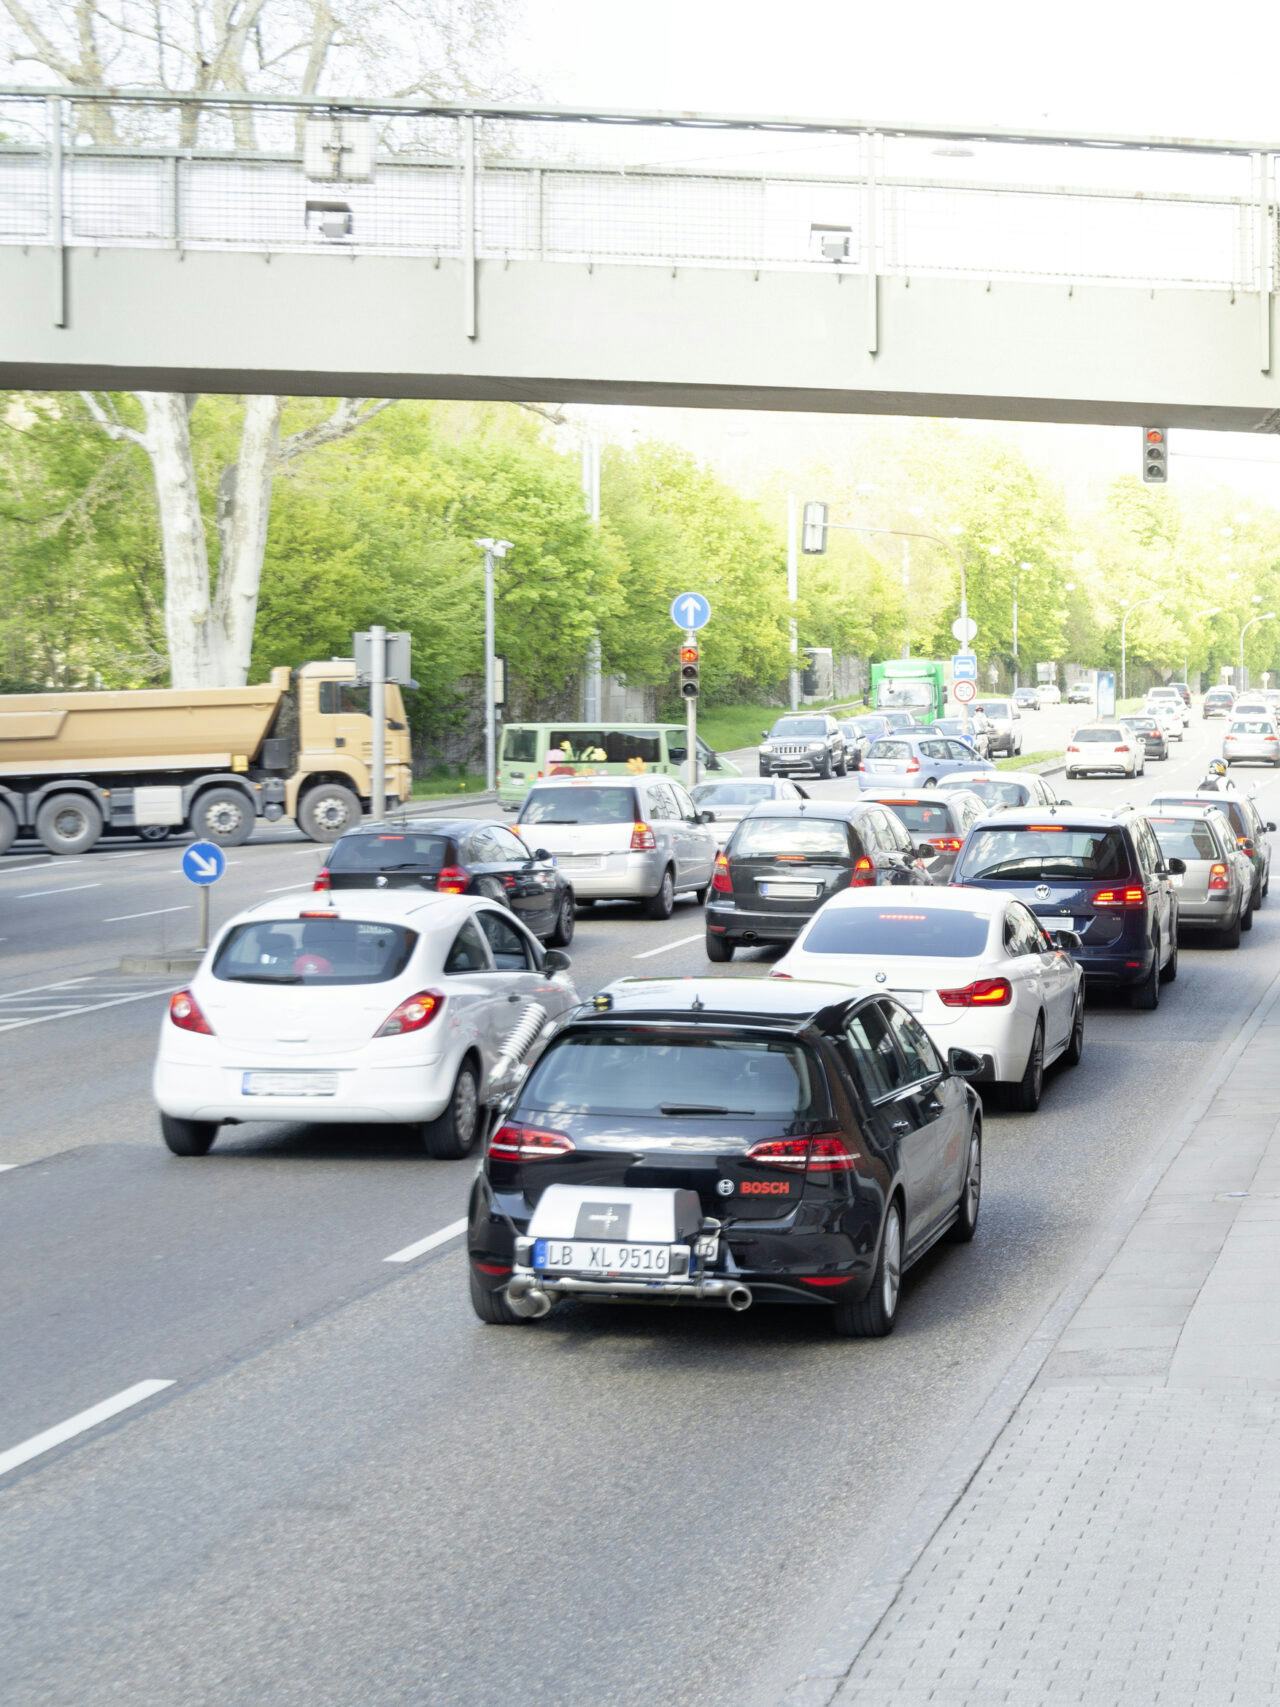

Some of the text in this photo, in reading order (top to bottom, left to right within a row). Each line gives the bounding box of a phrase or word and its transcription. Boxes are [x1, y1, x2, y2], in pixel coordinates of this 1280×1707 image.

[958, 686, 971, 697] 50
[740, 1181, 790, 1194] BOSCH
[549, 1245, 667, 1270] LB XL 9516
